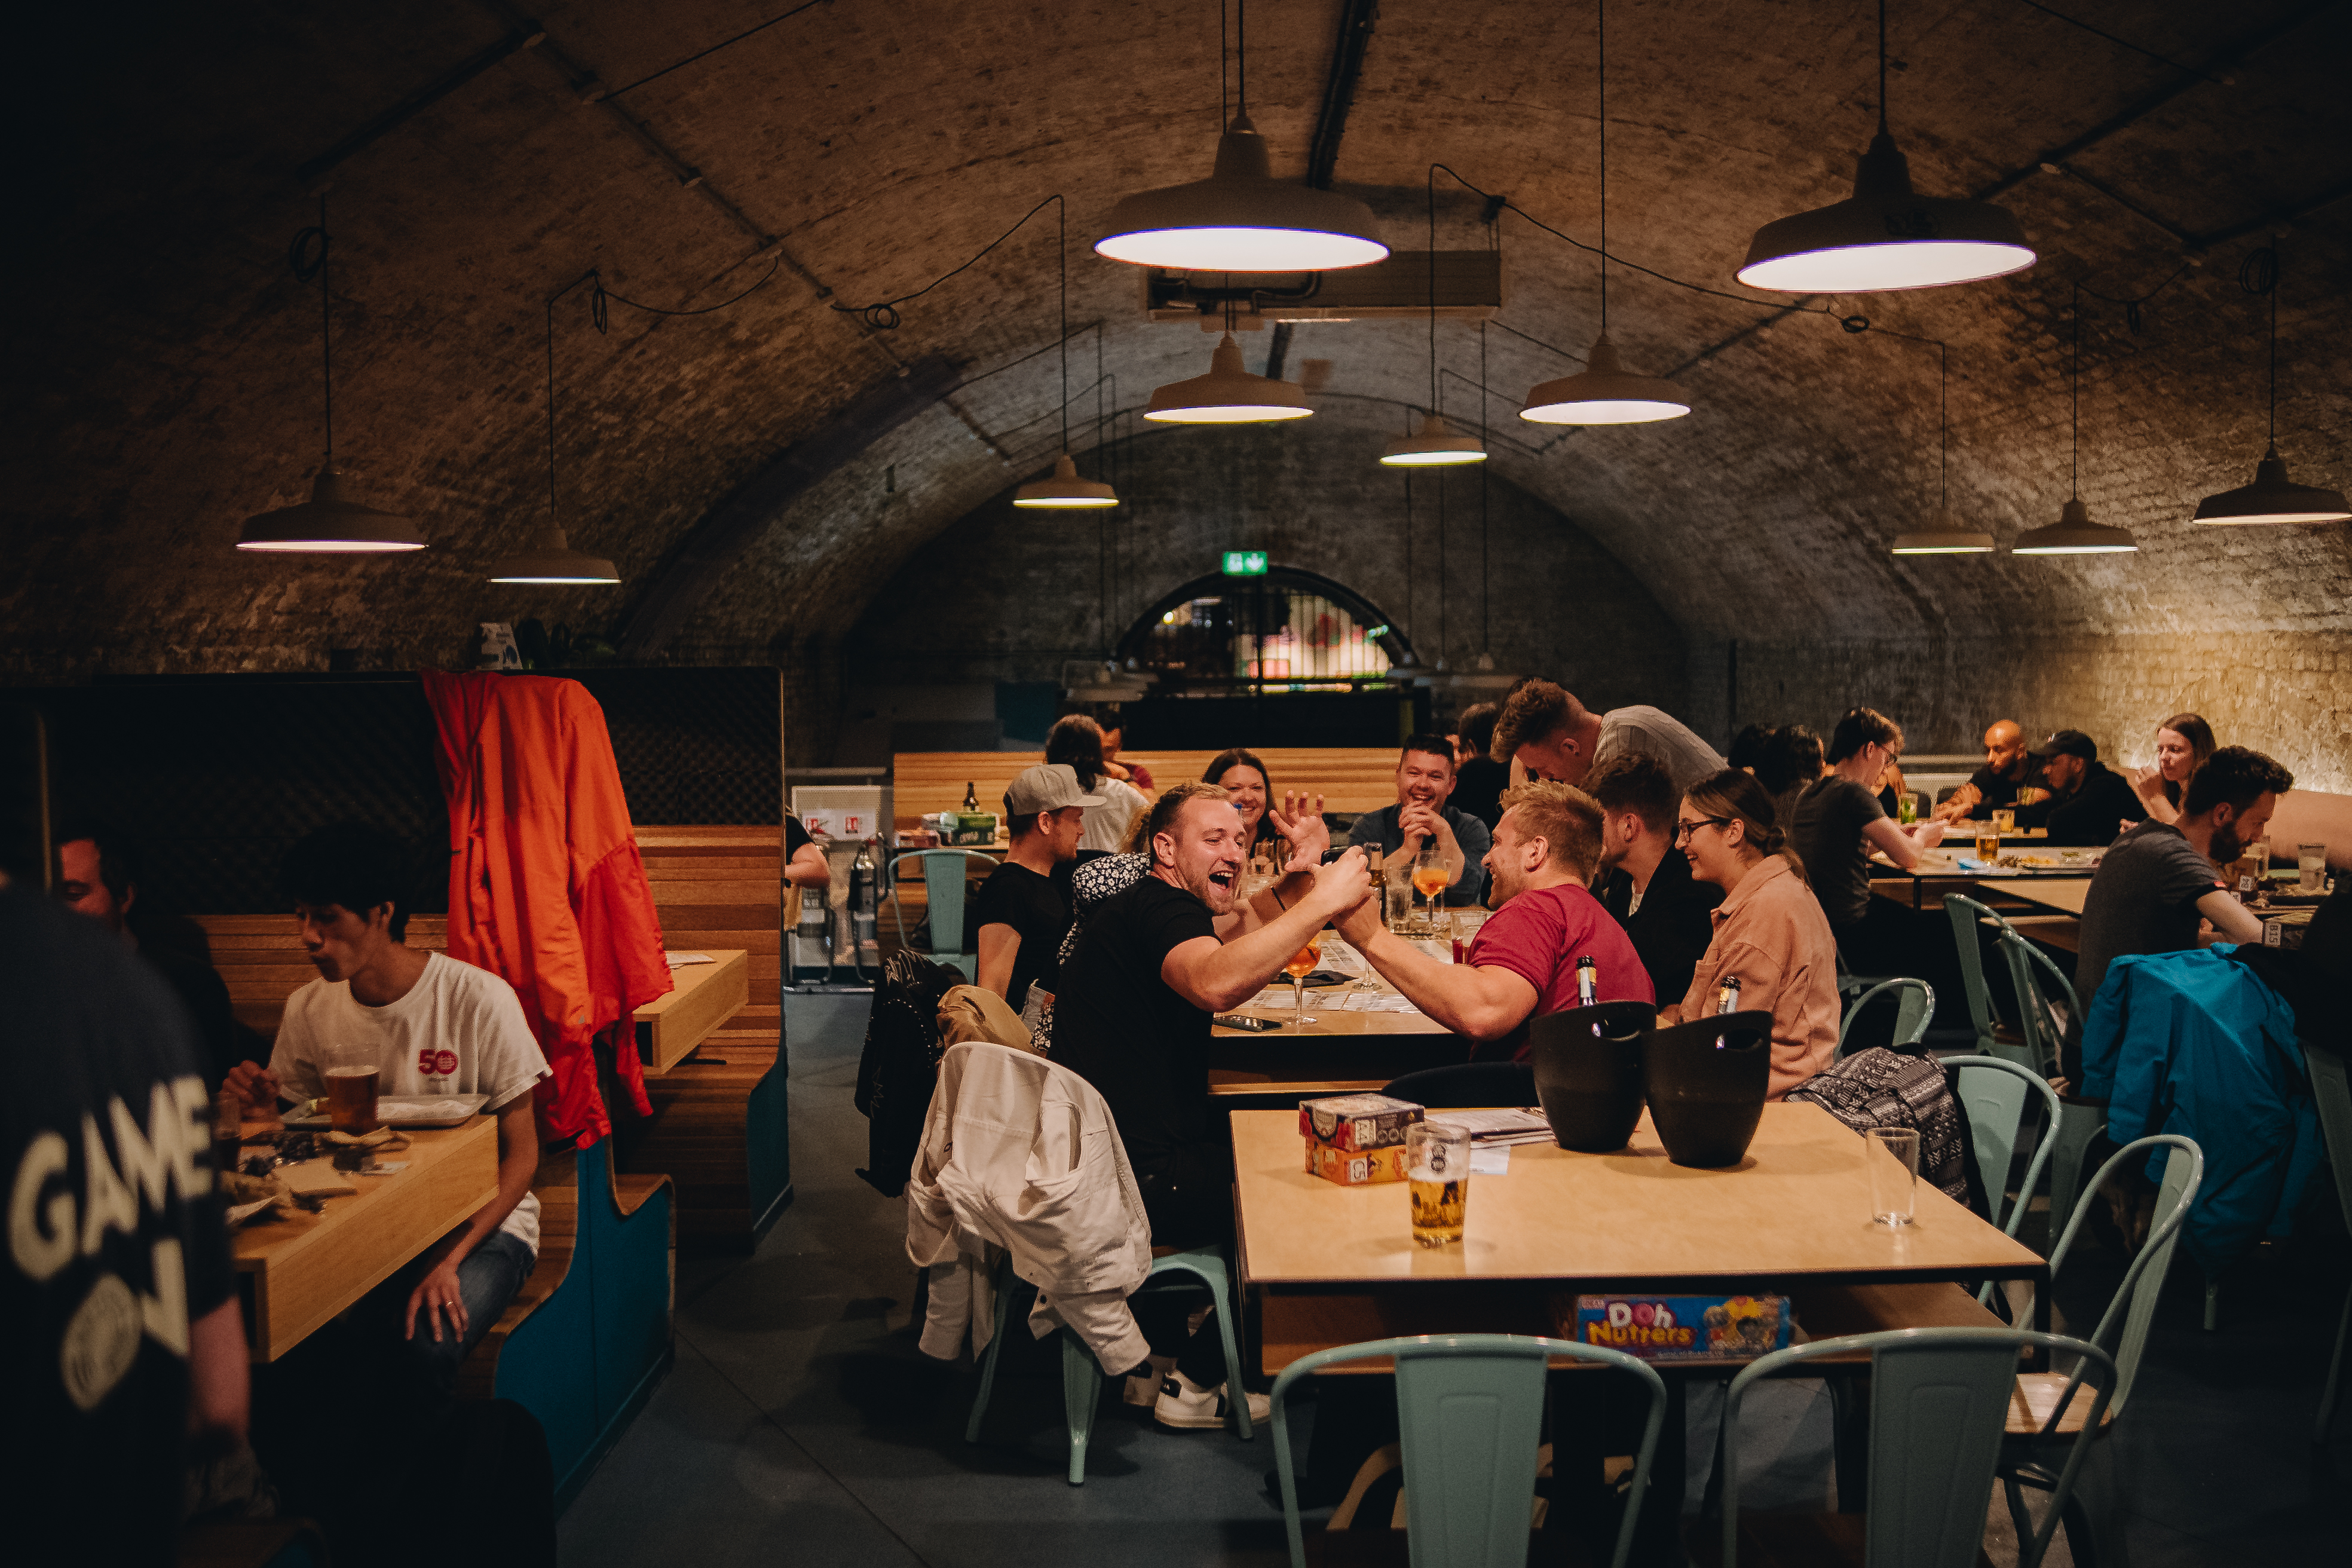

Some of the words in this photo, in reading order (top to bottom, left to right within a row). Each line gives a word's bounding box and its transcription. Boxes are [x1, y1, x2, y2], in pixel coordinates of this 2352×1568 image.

[2269, 924, 2278, 943] B15
[419, 1049, 458, 1074] 50
[5, 1073, 213, 1281] GAME
[1353, 1160, 1366, 1180] C5
